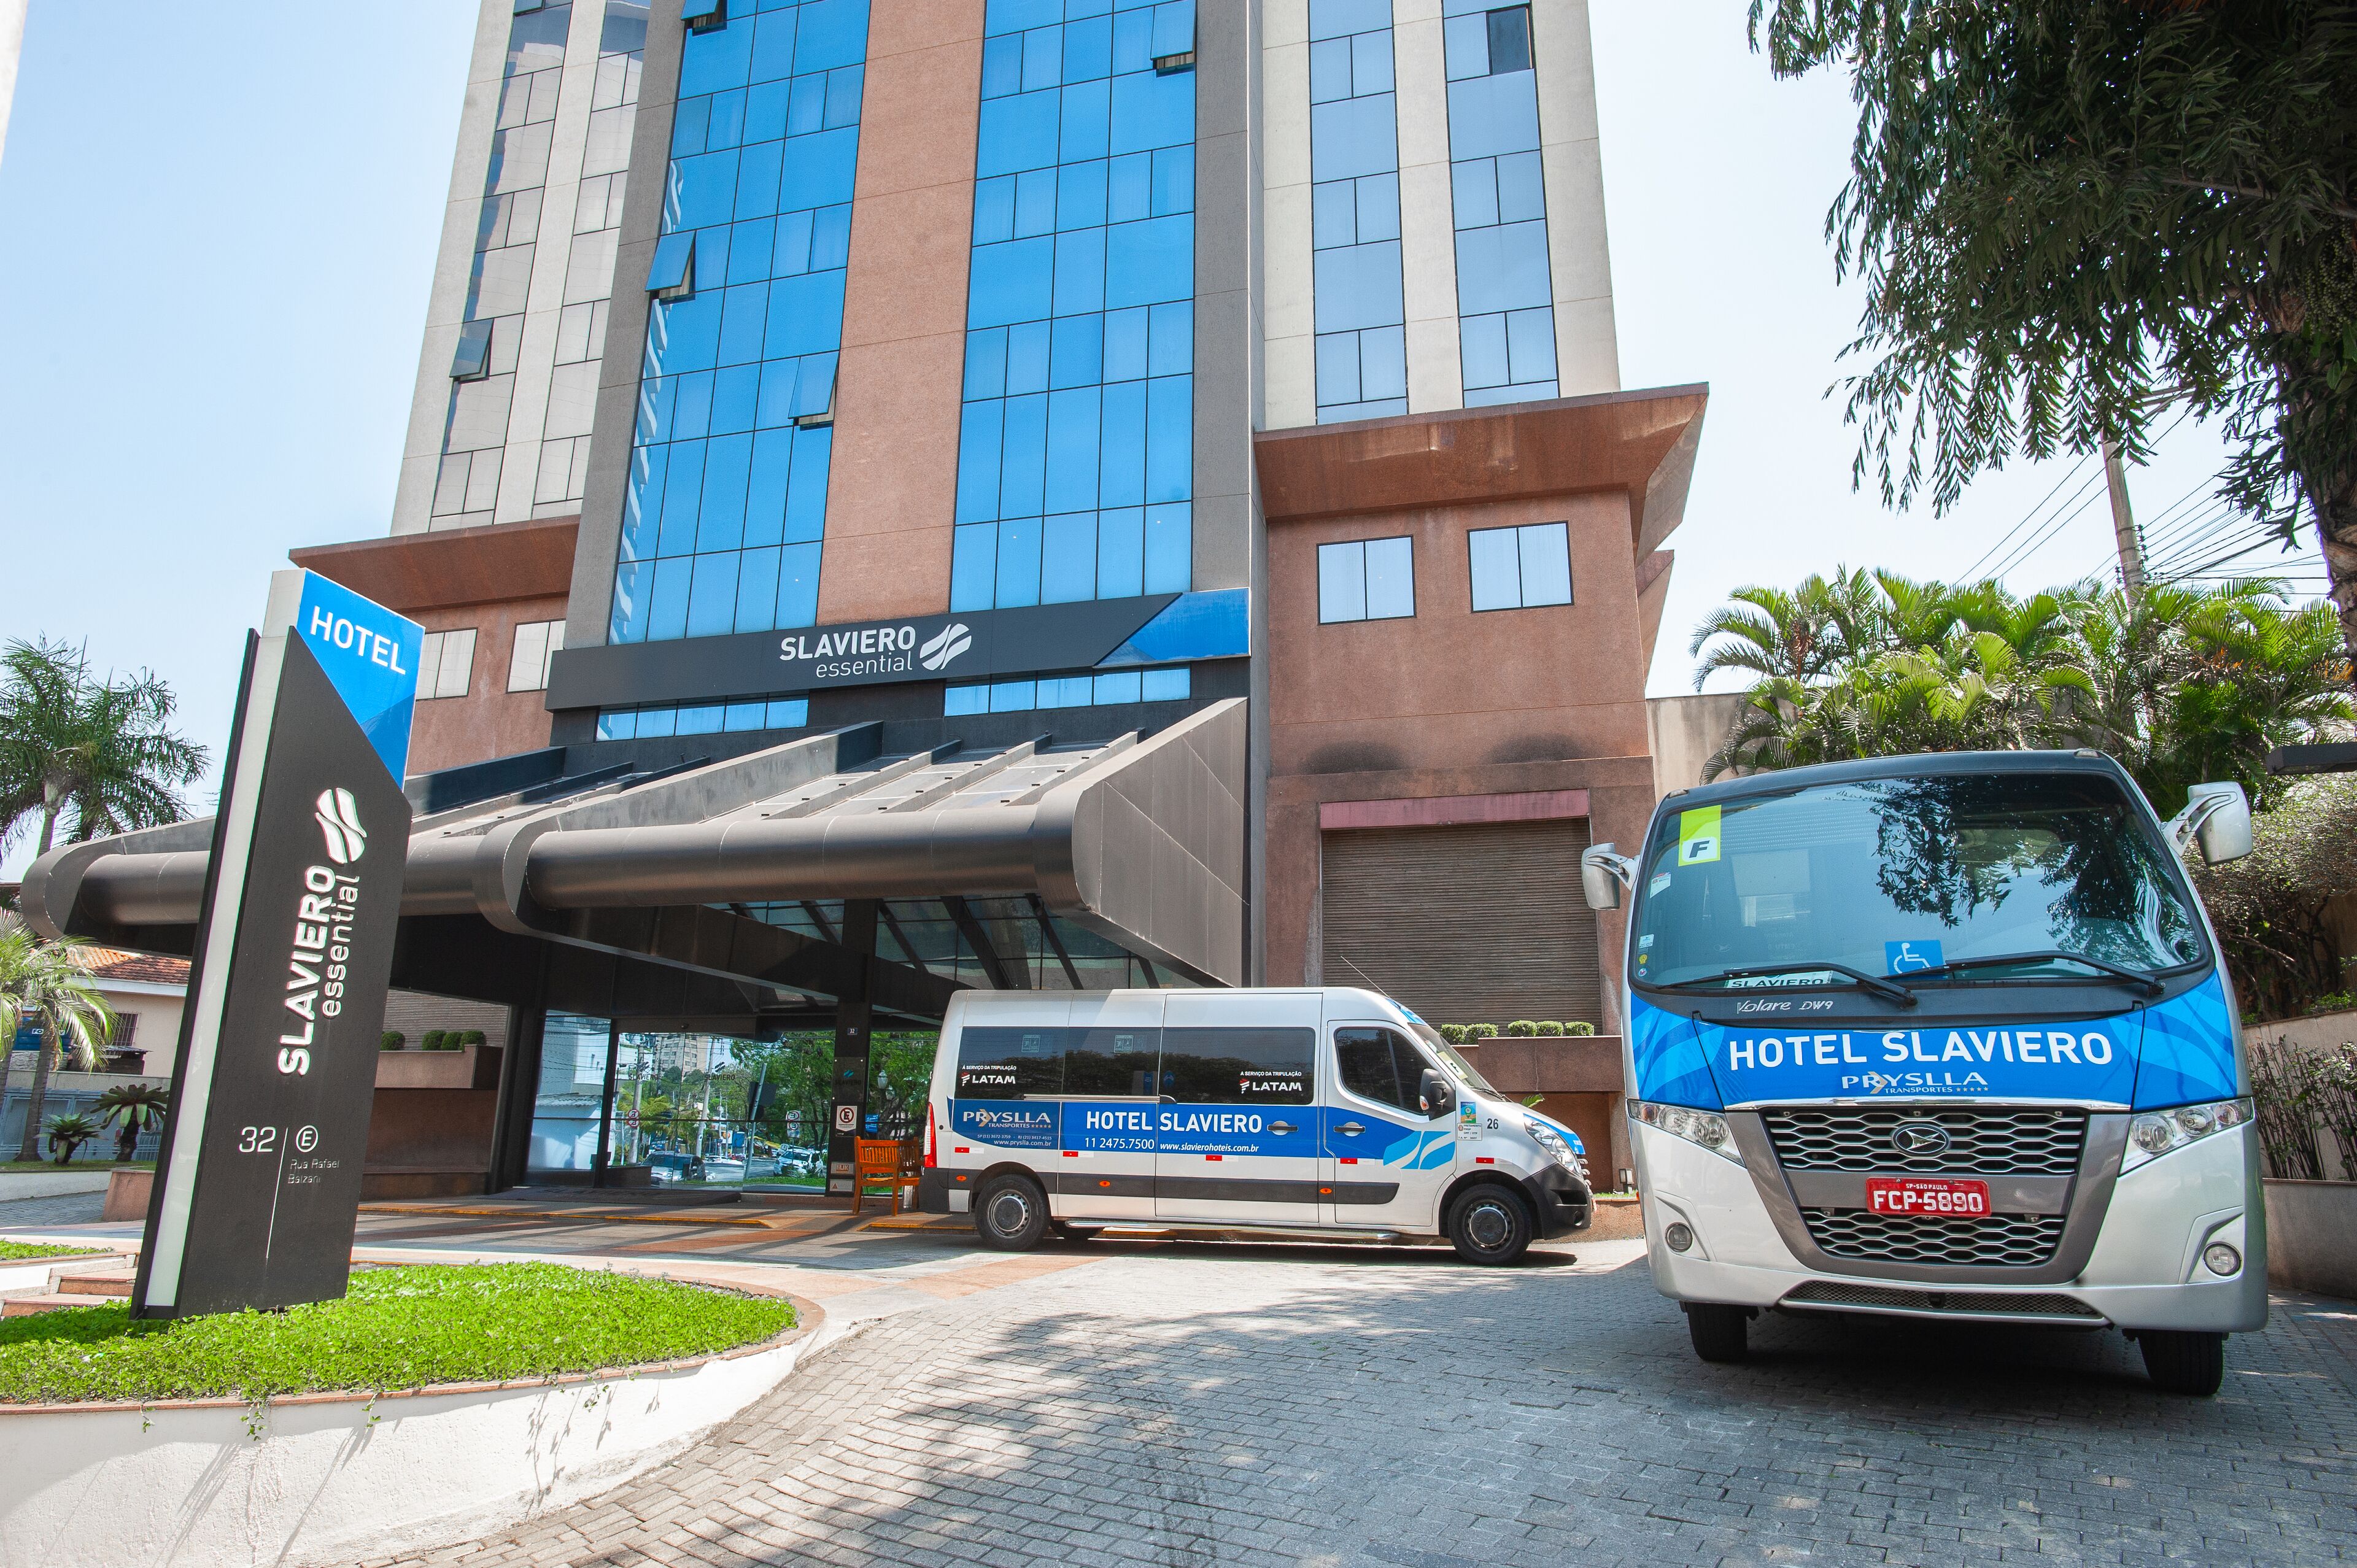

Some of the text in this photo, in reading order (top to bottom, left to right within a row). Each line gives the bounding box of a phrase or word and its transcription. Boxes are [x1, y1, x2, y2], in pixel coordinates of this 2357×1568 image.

[310, 605, 406, 675] HOTEL
[779, 625, 916, 661] SLAVIERO
[816, 651, 913, 678] essential
[1689, 840, 1710, 859] F
[322, 874, 360, 1018] essential
[278, 865, 336, 1075] SLAVIERO
[1731, 978, 1824, 987] SLAVIERO
[1737, 999, 1833, 1013] Volare DW9
[1729, 1031, 2113, 1071] HOTEL SLAVIERO
[972, 1075, 1016, 1084] LATAM
[1252, 1082, 1302, 1091] LATAM
[1841, 1072, 1988, 1089] PRYSLLA
[963, 1111, 1051, 1123] PRYSLLA
[1086, 1111, 1262, 1134] HOTEL SLAVIERO
[1487, 1118, 1499, 1129] 26
[239, 1126, 276, 1153] 32
[1085, 1137, 1155, 1149] 11 2475.7500
[1160, 1142, 1259, 1153] www.slavierohoteis.com.br
[290, 1158, 339, 1169] Rua Rafael
[287, 1173, 321, 1184] Balzani
